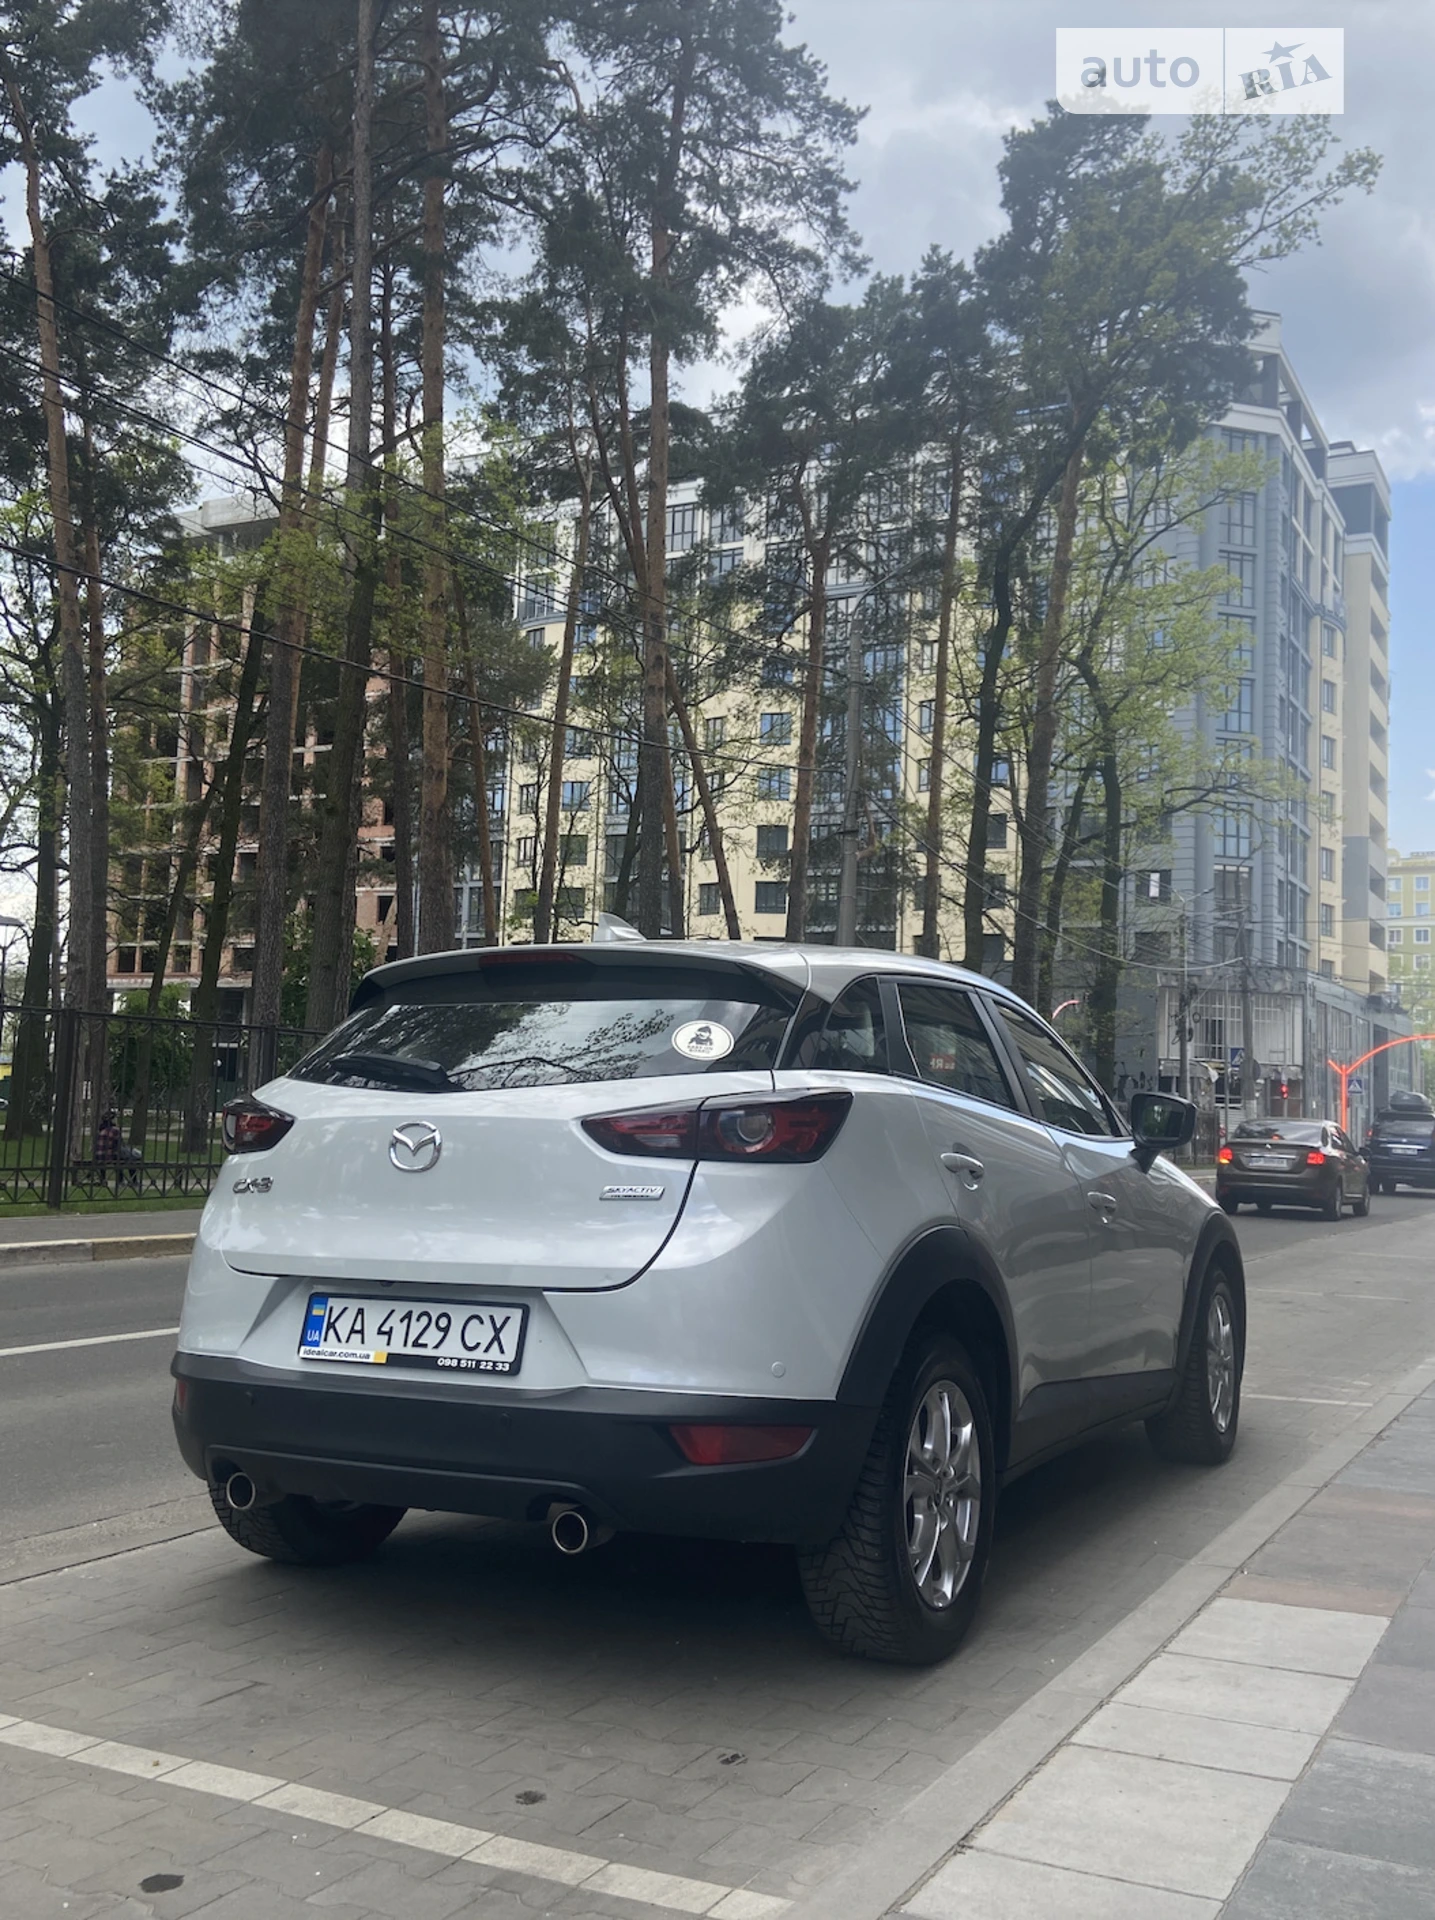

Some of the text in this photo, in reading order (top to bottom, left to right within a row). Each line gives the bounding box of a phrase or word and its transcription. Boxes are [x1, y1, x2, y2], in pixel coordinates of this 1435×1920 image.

[307, 1330, 320, 1342] UA
[323, 1306, 511, 1355] KA 4129 CX
[303, 1347, 371, 1360] idealcar.com.ua
[437, 1358, 510, 1371] 098 511 22 33
